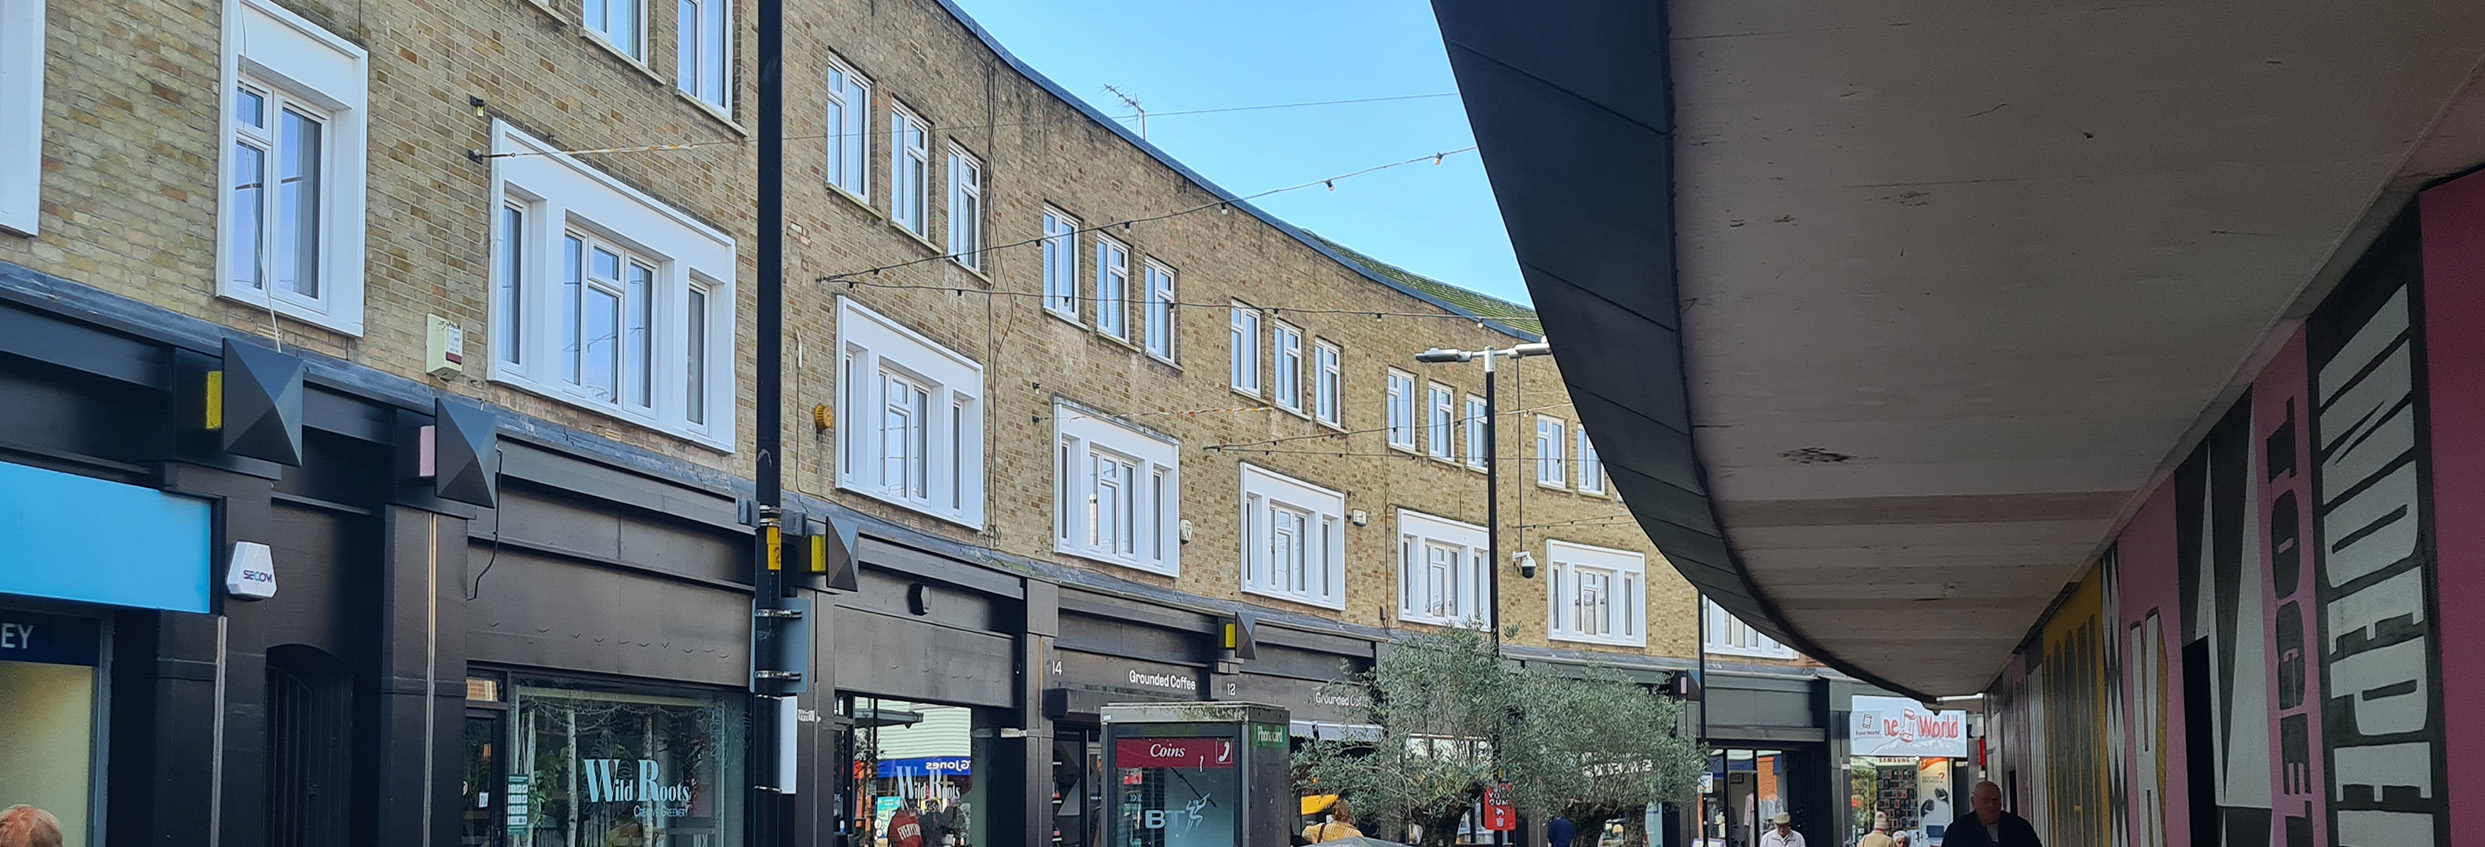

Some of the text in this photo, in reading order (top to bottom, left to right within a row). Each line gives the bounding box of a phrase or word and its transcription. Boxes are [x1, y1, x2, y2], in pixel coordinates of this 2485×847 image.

[2318, 283, 2435, 847] INDEPE
[243, 569, 273, 584] SECOM
[1, 623, 35, 650] EY
[1052, 660, 1063, 676] 14
[1129, 669, 1196, 690] Grounded Coffee
[1226, 682, 1236, 696] 12
[1918, 714, 1959, 738] World
[1150, 742, 1186, 759] Coins
[584, 758, 691, 802] Wild Roots
[896, 766, 926, 800] Wild
[1145, 809, 1186, 829] BT
